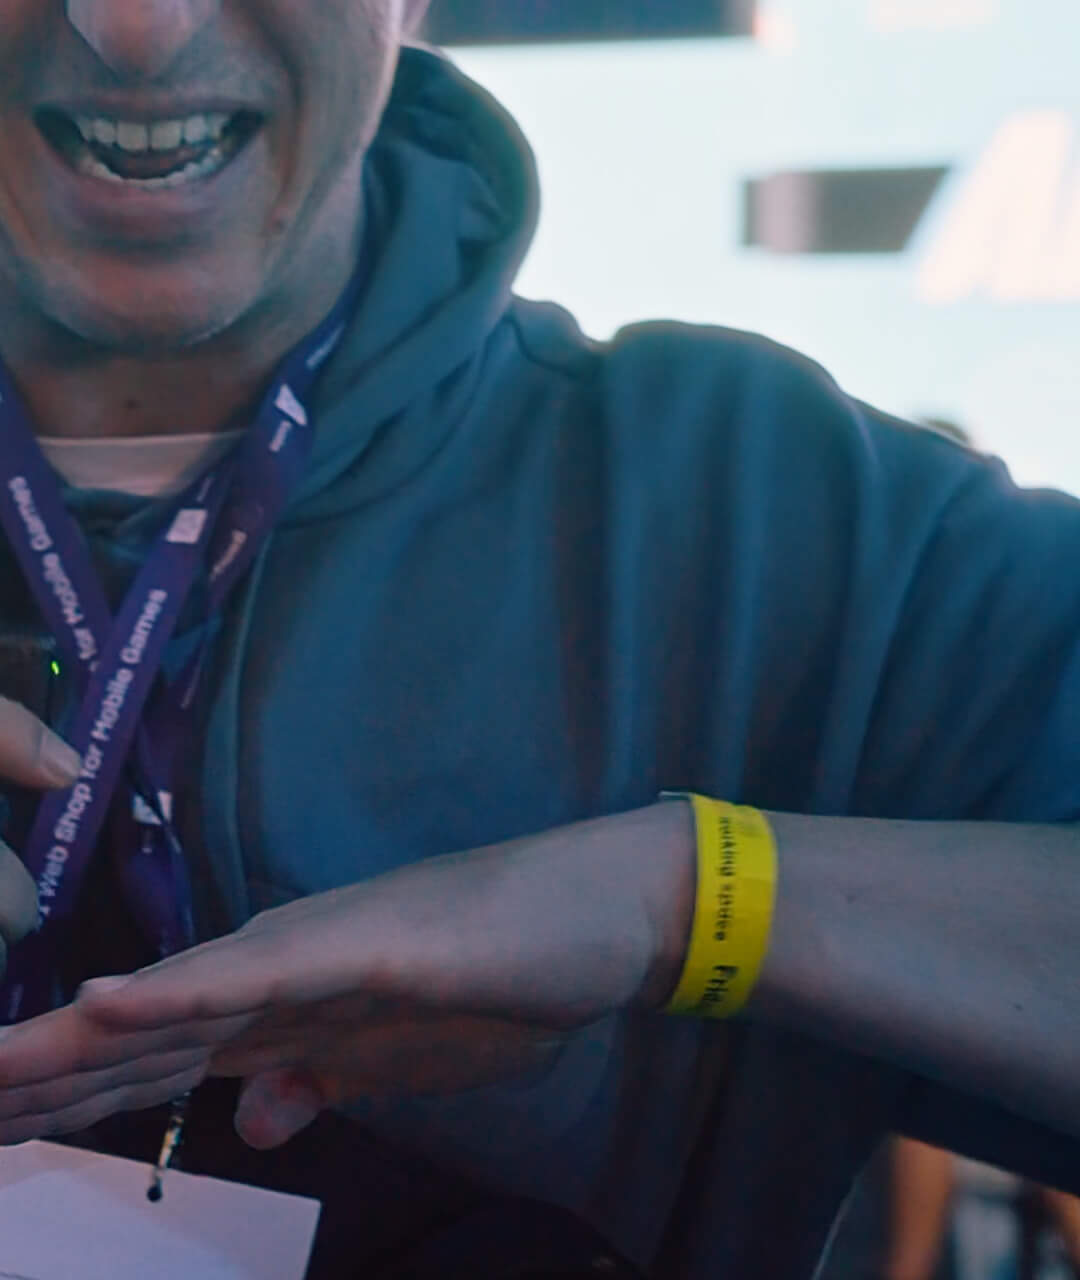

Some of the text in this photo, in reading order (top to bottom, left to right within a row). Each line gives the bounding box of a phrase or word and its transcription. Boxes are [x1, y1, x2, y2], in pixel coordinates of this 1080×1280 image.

[7, 475, 53, 552] Games
[122, 587, 169, 665] Games
[91, 666, 134, 742] Mobile
[81, 747, 106, 793] for
[53, 780, 93, 844] Shop
